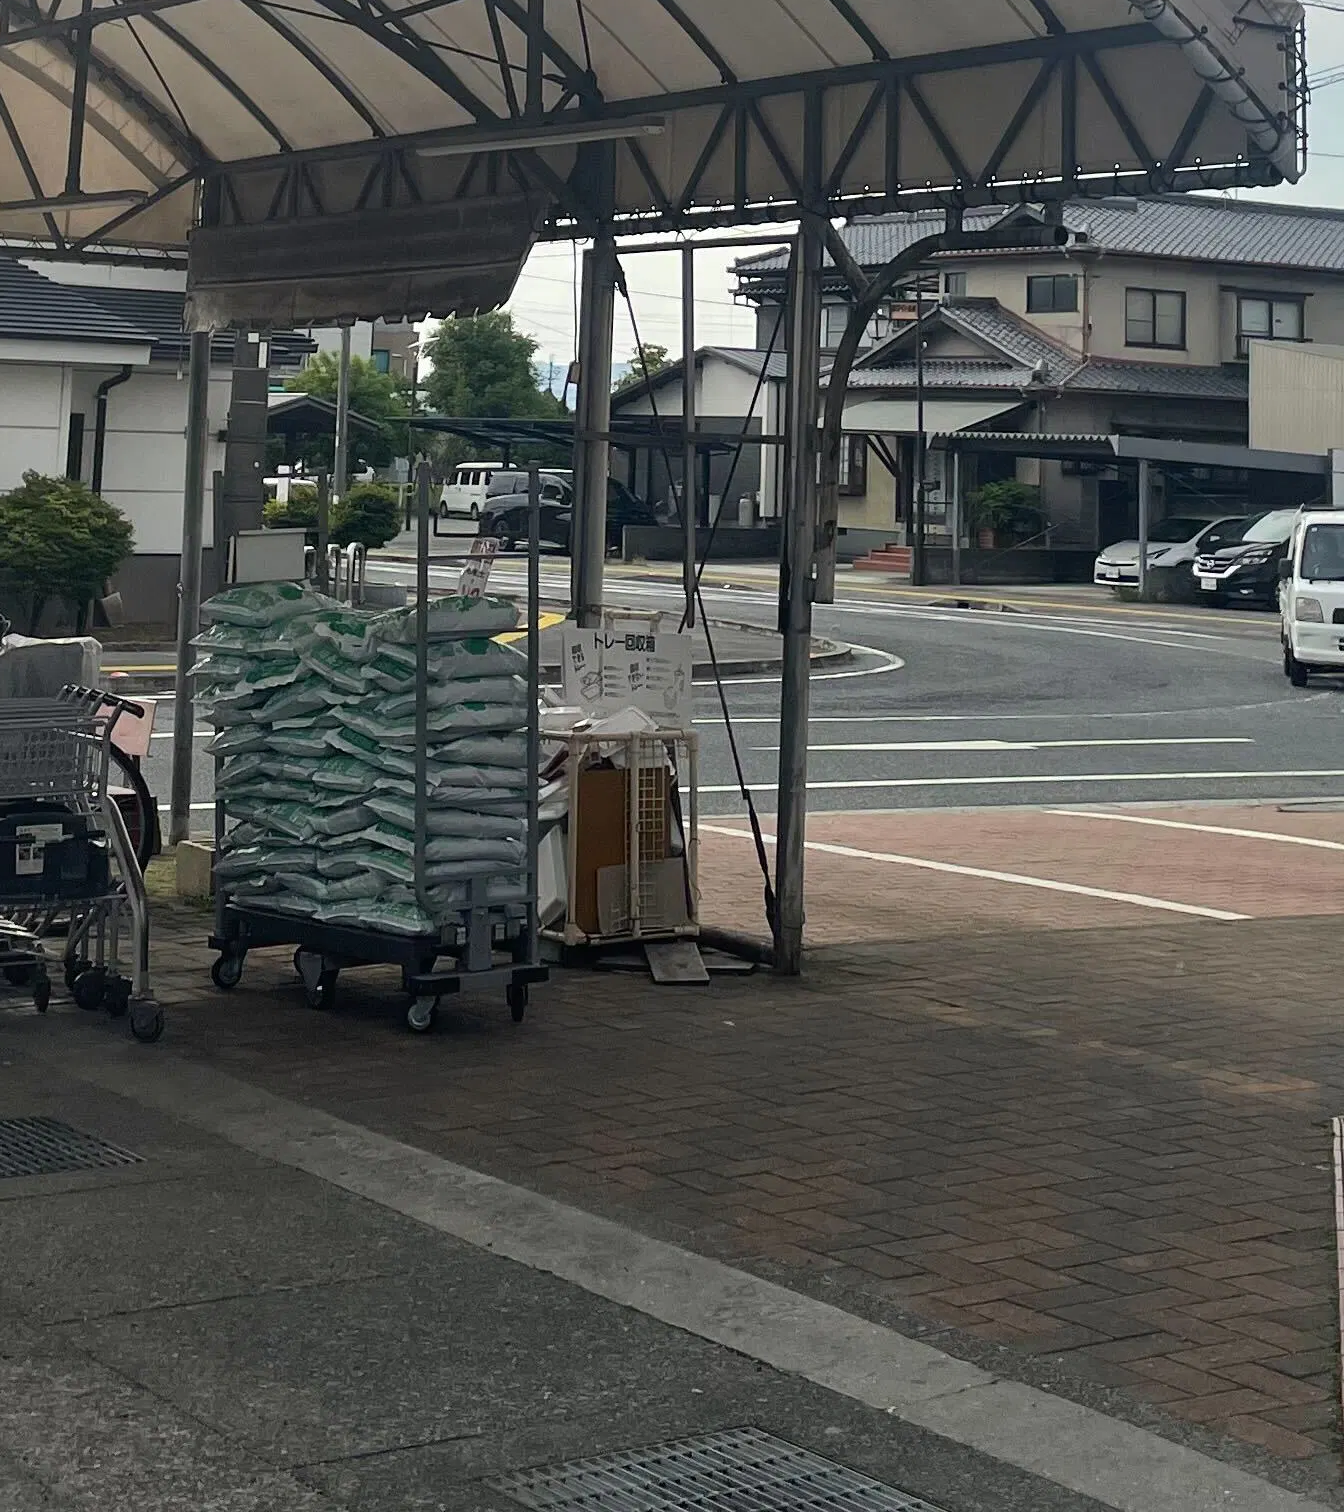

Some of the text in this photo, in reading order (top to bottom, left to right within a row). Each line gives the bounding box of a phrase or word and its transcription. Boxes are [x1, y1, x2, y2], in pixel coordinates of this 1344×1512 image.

[594, 632, 656, 653] トレー回収箱
